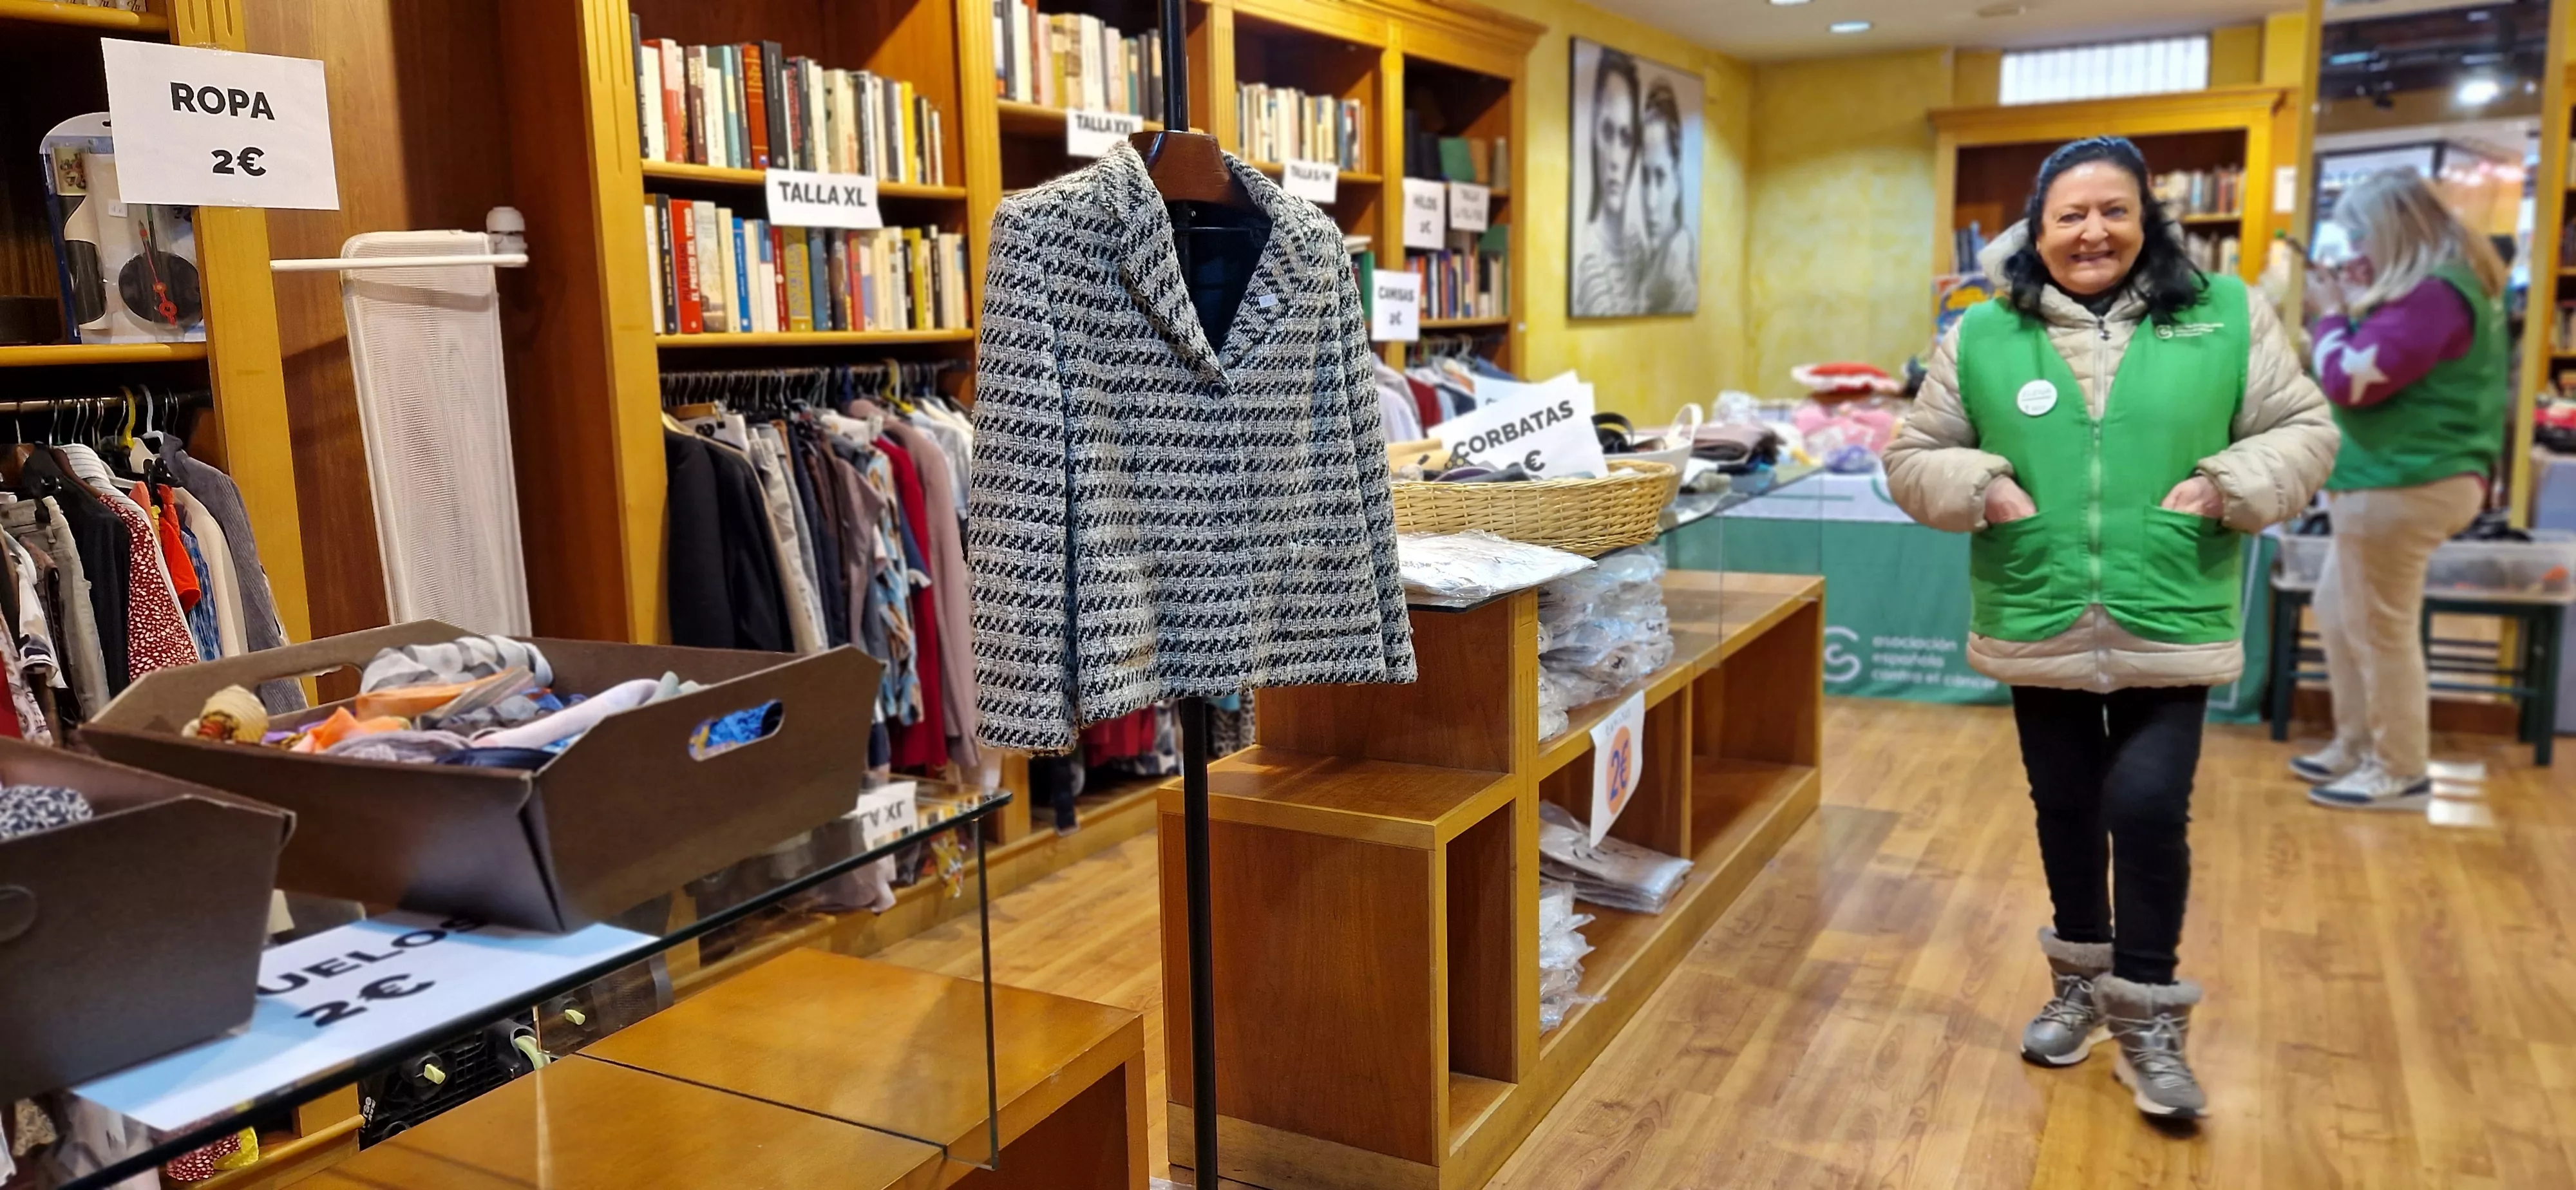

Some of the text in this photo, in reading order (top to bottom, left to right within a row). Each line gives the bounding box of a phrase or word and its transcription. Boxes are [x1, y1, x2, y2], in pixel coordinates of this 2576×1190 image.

[170, 82, 275, 120] ROPA
[1075, 115, 1112, 133] TALLA
[211, 147, 267, 176] 2€
[778, 181, 867, 207] TALLA XL
[1452, 400, 1574, 458] CORBATAS
[1611, 739, 1629, 800] 2€
[256, 912, 488, 996] UELOS
[294, 974, 435, 1028] 2€
